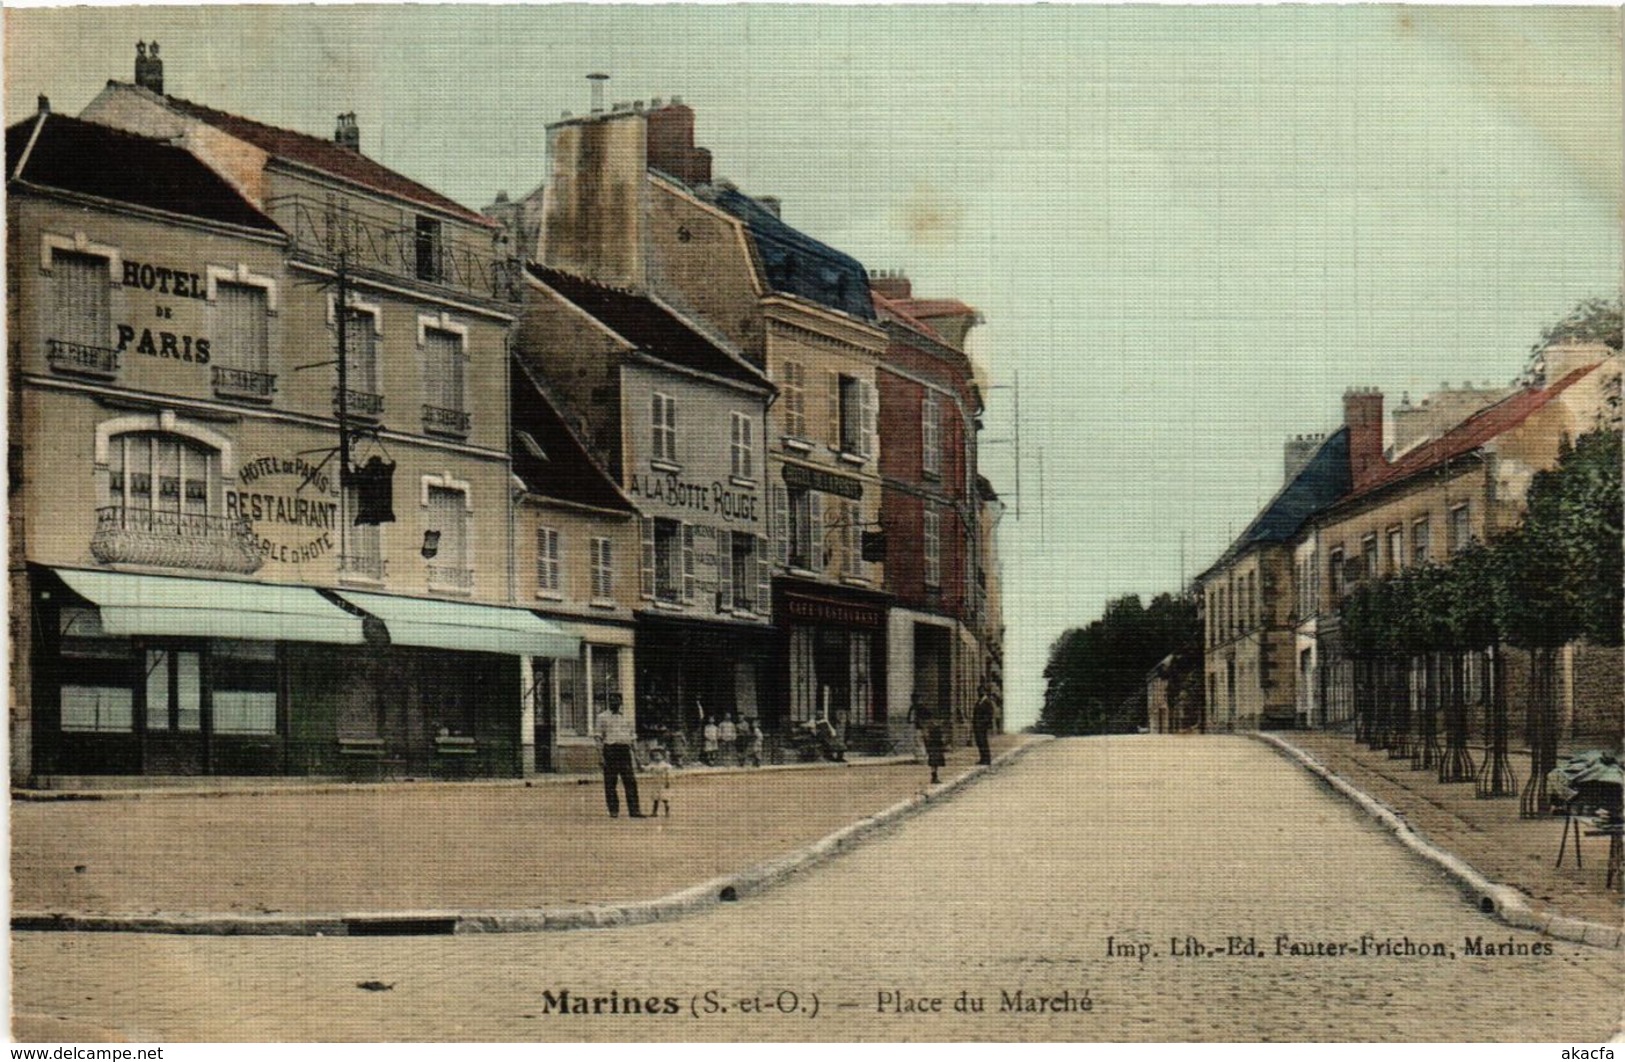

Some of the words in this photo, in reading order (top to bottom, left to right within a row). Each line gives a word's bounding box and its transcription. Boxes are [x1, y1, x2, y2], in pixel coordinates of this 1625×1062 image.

[122, 260, 207, 301] HOTEL
[155, 305, 172, 319] DE
[117, 324, 210, 364] PARIS
[226, 491, 337, 530] RESTAURANT
[630, 474, 640, 496] A
[645, 475, 664, 500] LA
[666, 473, 709, 511] BOTTE
[712, 481, 758, 522] ROUGE
